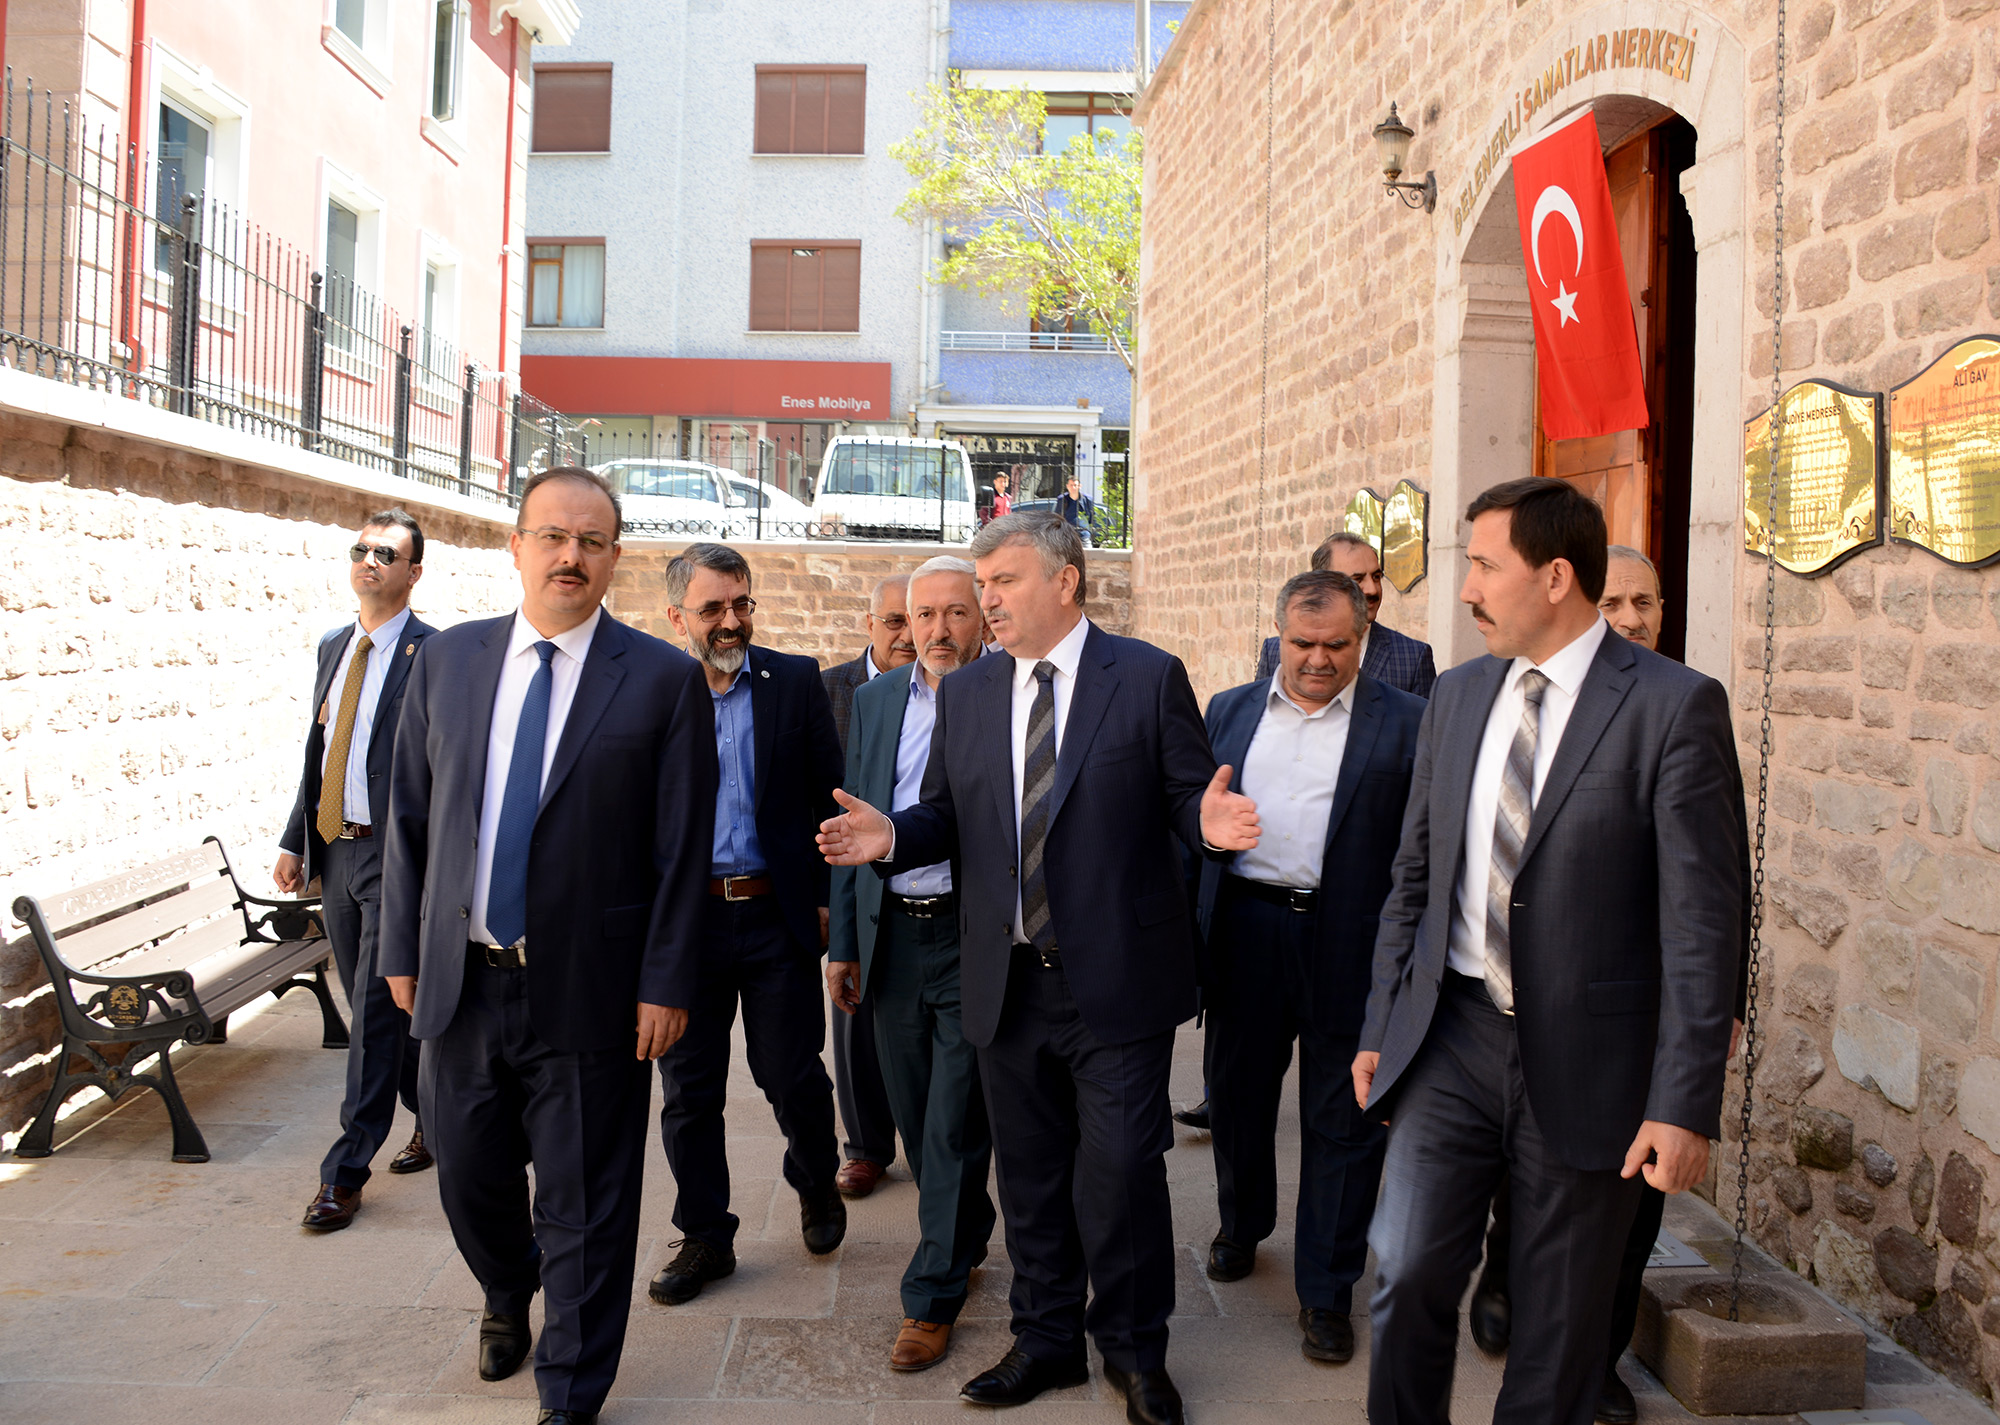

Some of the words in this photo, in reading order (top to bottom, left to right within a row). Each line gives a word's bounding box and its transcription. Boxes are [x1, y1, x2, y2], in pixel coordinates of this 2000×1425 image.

[1454, 92, 1521, 237] GELENEKLİ
[1523, 34, 1608, 123] SANATLAR
[1611, 27, 1698, 83] MERKEZİ
[1969, 367, 1988, 384] GAV
[781, 395, 815, 408] Enes
[818, 397, 871, 412] Mobilya
